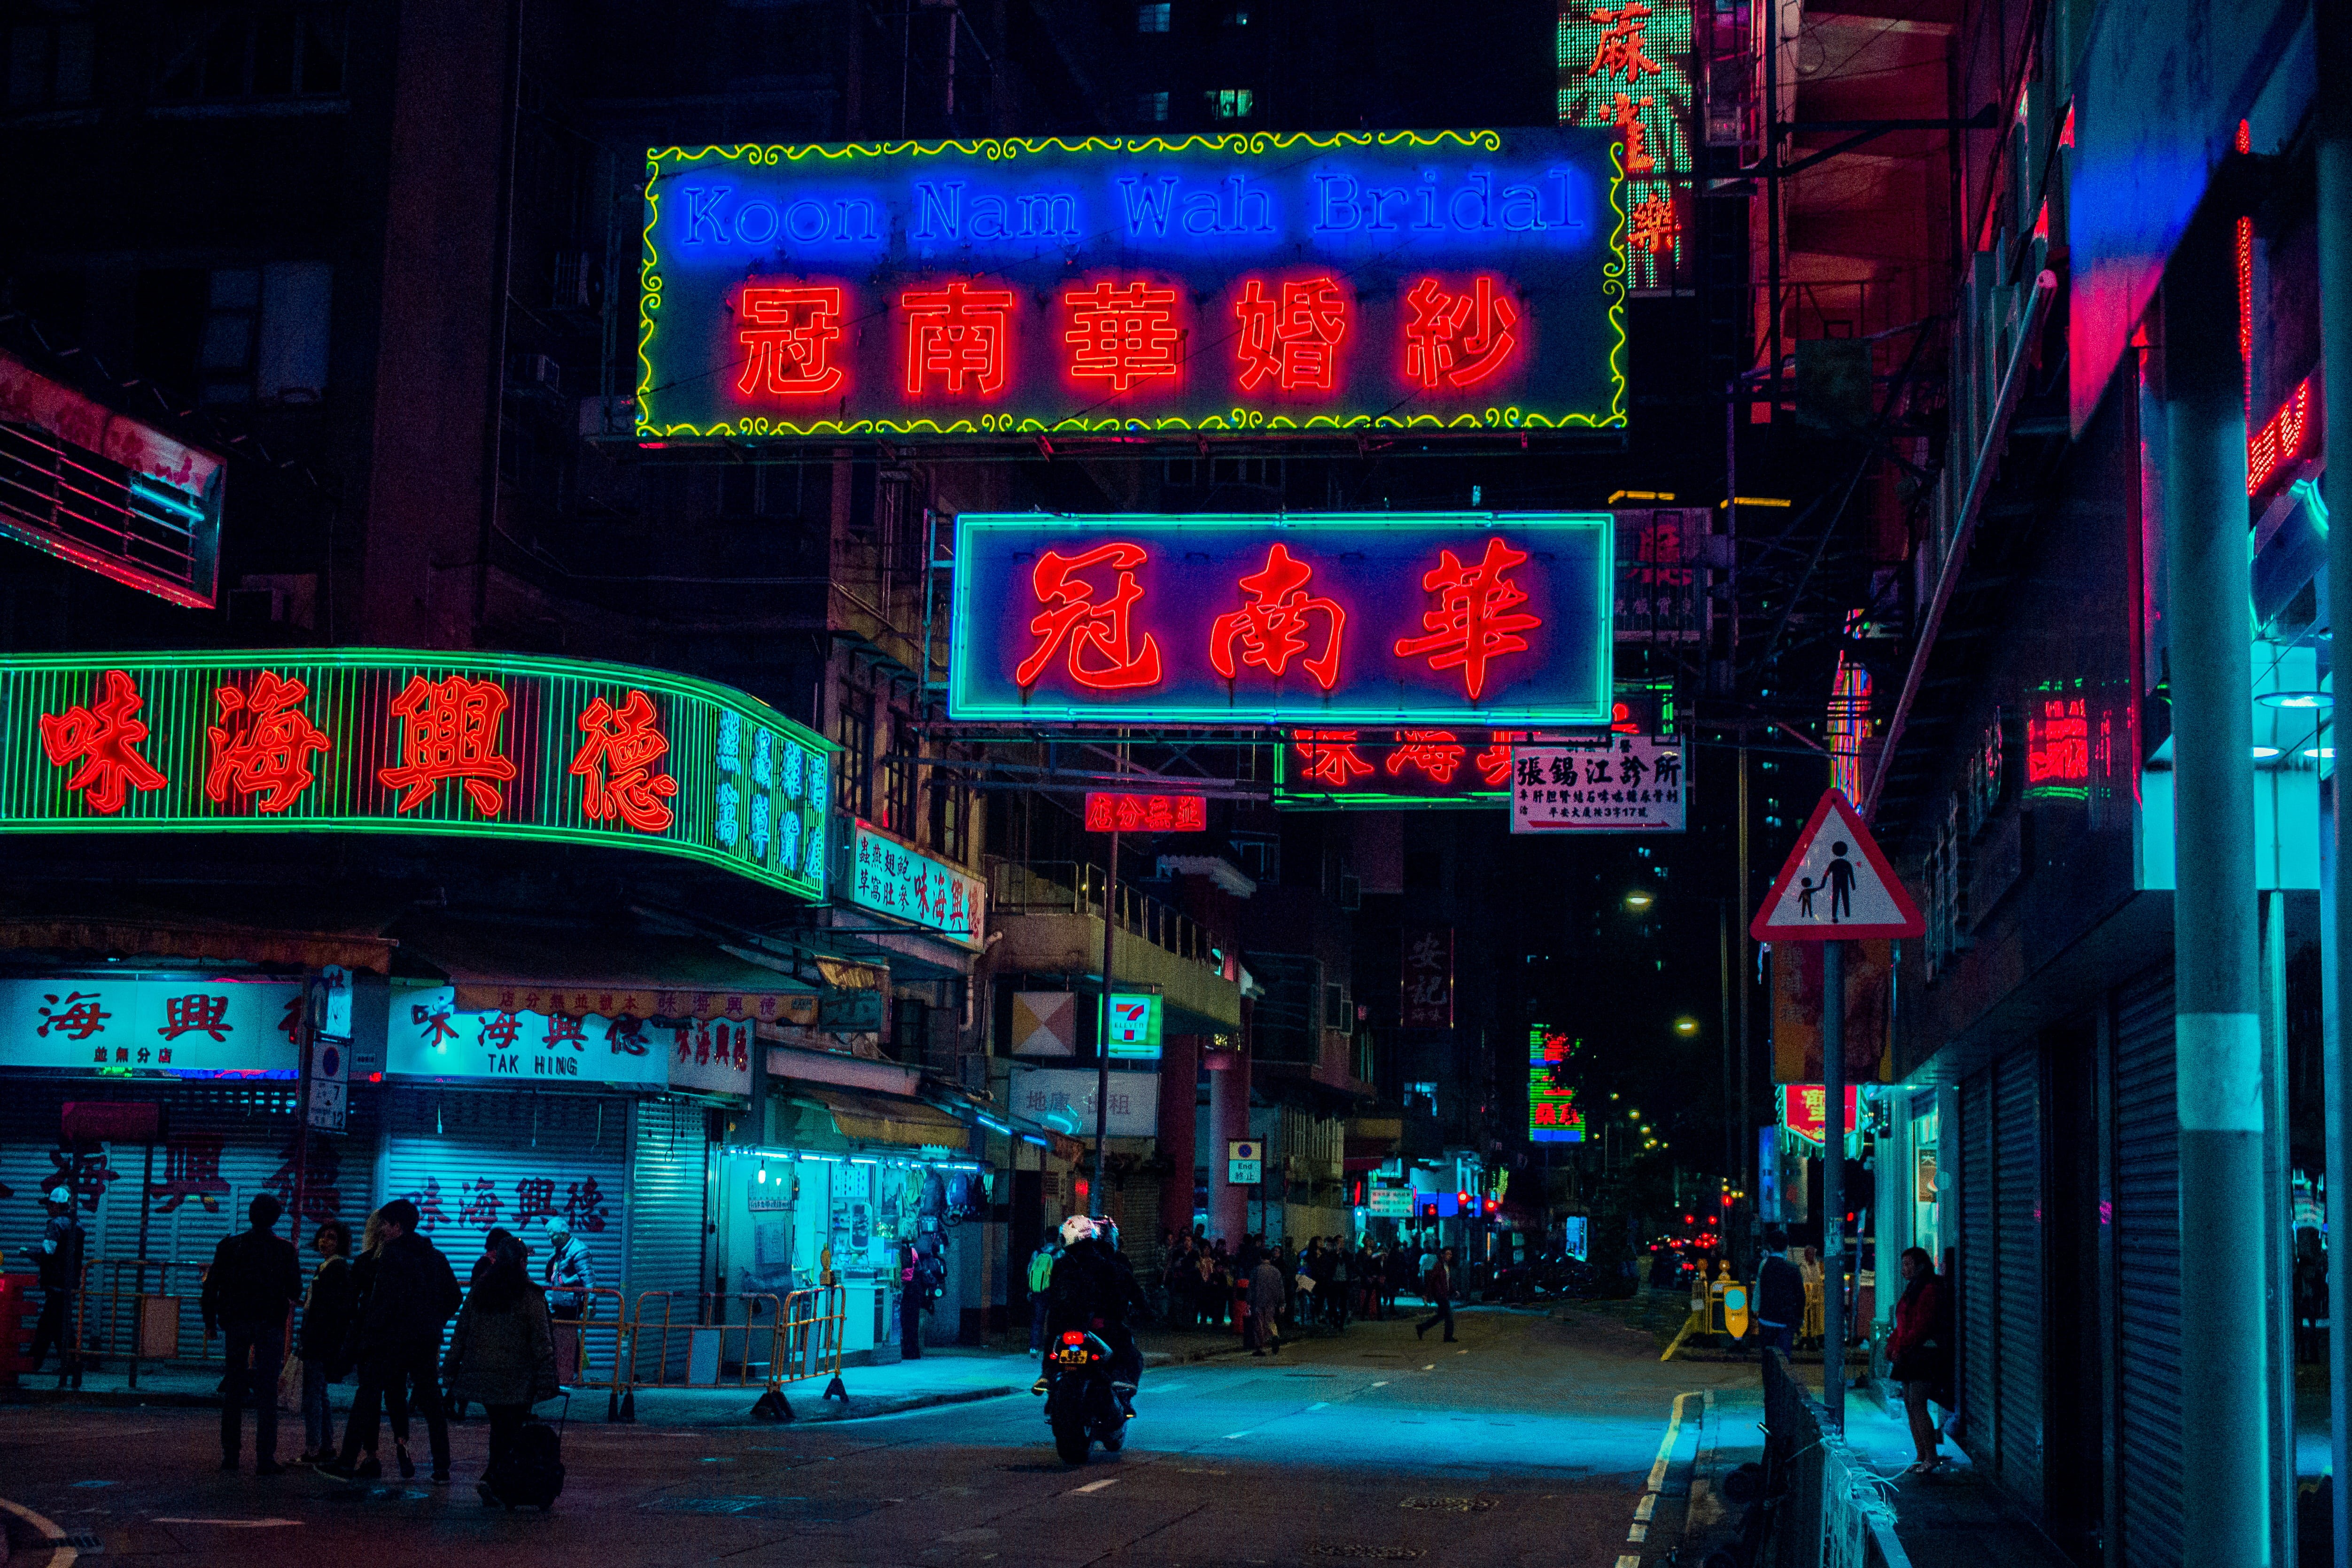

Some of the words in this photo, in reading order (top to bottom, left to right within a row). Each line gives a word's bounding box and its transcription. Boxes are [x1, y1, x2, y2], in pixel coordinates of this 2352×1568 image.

[682, 185, 880, 246] Koon
[914, 181, 1082, 244] Nam
[1117, 173, 1275, 238] Wah
[1313, 168, 1584, 233] Bridal
[735, 275, 1517, 396] 冠南華婚紗
[1016, 537, 1543, 700] 冠南華
[1518, 755, 1682, 788] 張錫江診所
[93, 1048, 173, 1064] 並無分店
[488, 1054, 519, 1074] TAK
[535, 1056, 578, 1076] HING
[334, 1086, 340, 1101] 7
[334, 1111, 343, 1126] 12
